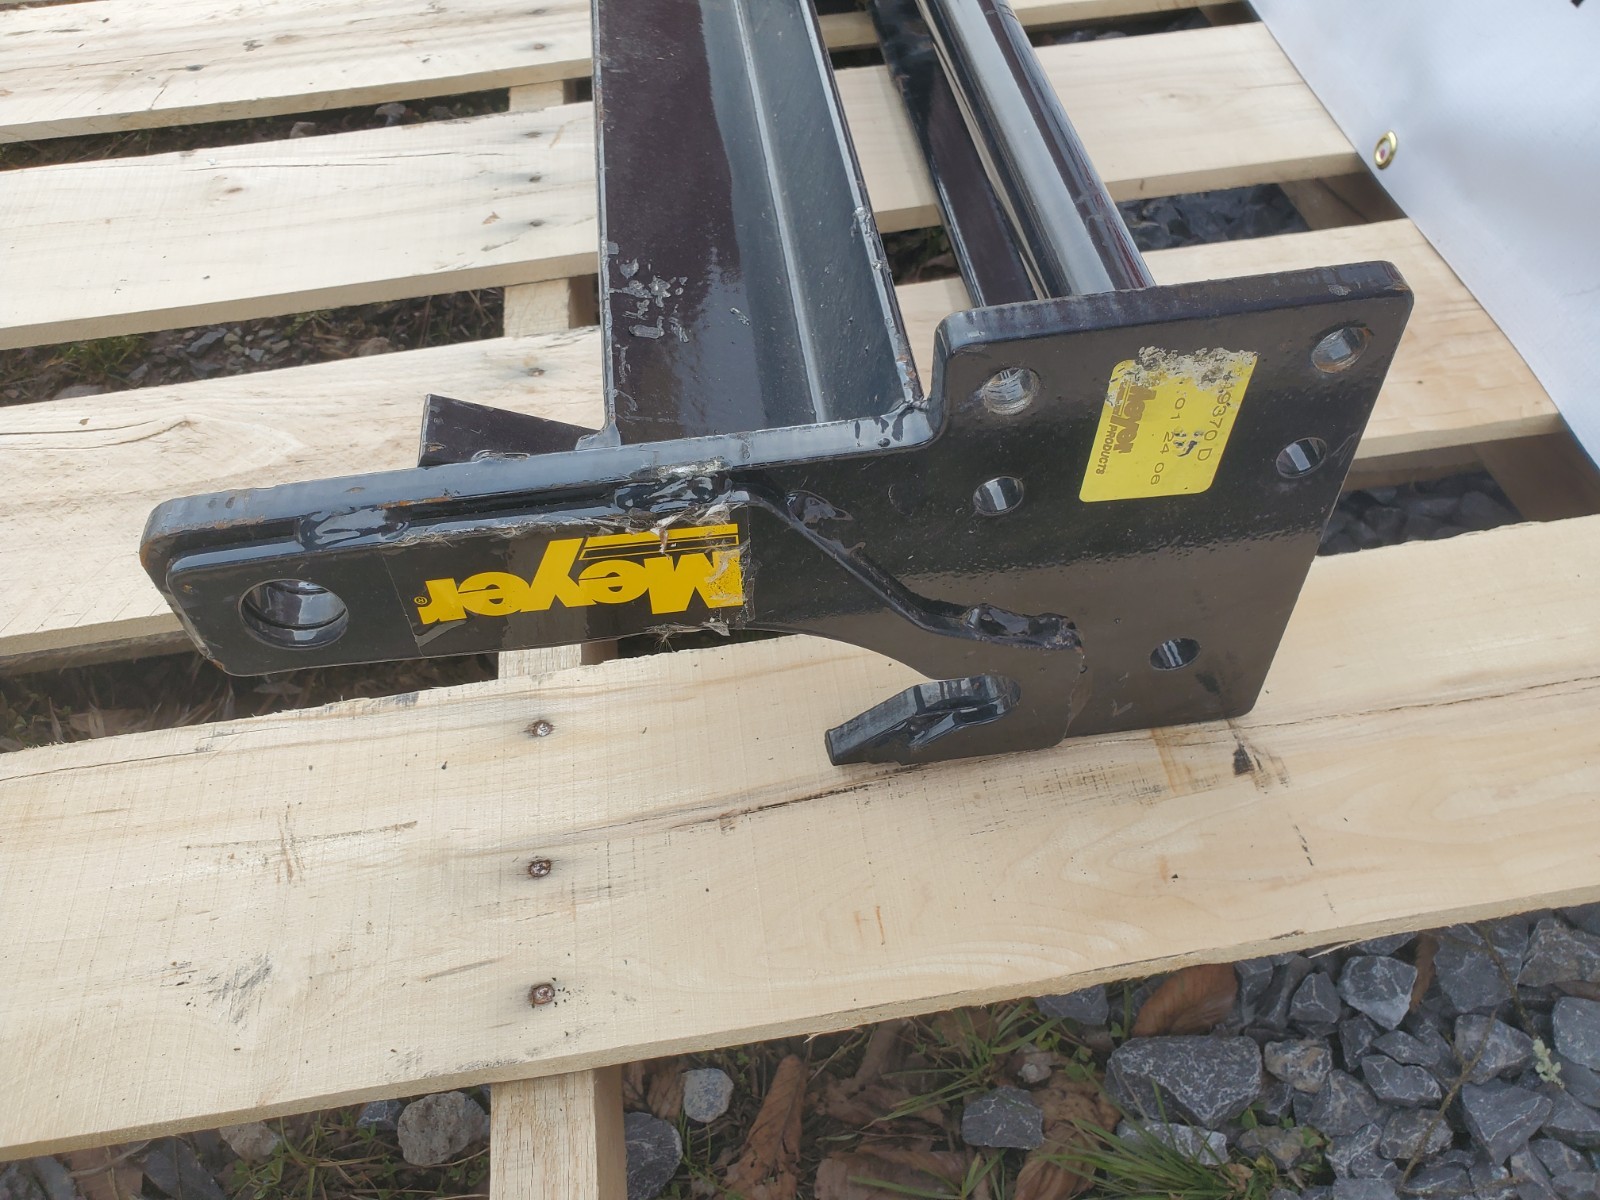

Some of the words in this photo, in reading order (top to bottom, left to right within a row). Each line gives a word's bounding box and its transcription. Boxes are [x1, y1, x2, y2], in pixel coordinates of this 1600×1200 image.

[1096, 424, 1118, 475] PRODUCTS
[1160, 431, 1174, 455] 24
[1197, 447, 1213, 461] D
